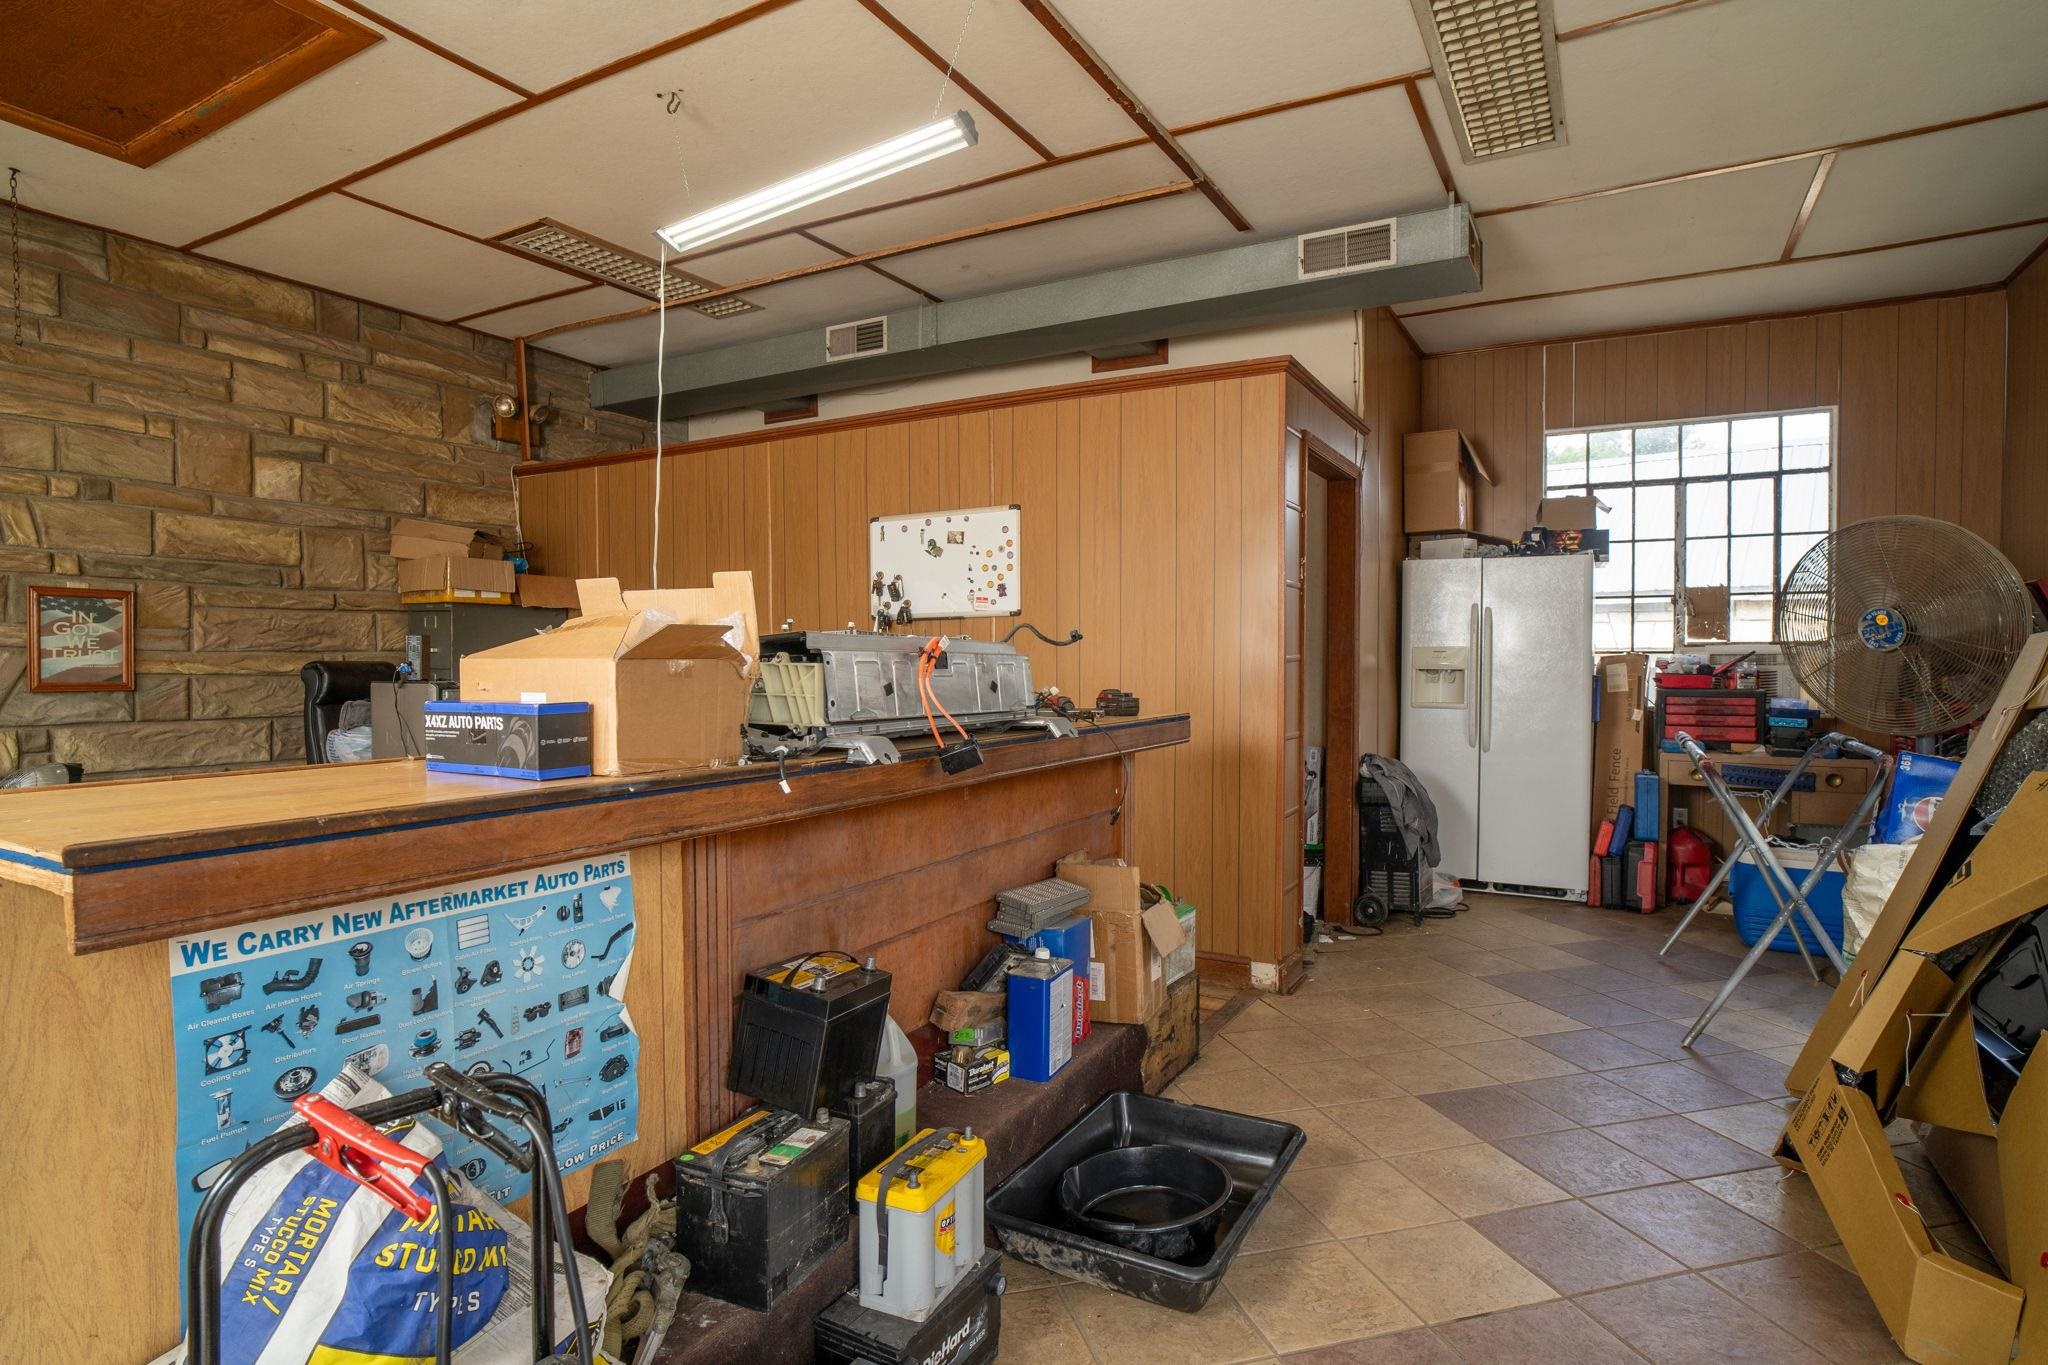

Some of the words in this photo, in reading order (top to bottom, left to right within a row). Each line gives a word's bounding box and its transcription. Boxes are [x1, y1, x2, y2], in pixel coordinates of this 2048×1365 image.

[71, 610, 94, 623] IN
[53, 622, 104, 635] GOD
[66, 636, 100, 649] WE
[46, 647, 119, 661] TRUST
[449, 716, 473, 730] AUTO
[474, 717, 504, 731] PARTS
[1608, 747, 1622, 782] Fence
[1899, 760, 1911, 771] 36
[1607, 786, 1619, 815] Field
[181, 940, 228, 968] WE
[237, 922, 325, 955] CARRY
[332, 909, 383, 936] NEW
[390, 879, 529, 924] AFTERMARKET
[534, 869, 579, 893] AUTO
[584, 857, 626, 882] PARTS
[343, 981, 355, 990] Air
[355, 976, 381, 989] Springs
[265, 1002, 277, 1011] Air
[277, 996, 300, 1007] Intake
[299, 990, 322, 1002] Hoses
[187, 1022, 200, 1031] Air
[200, 1015, 231, 1028] Cleaner
[231, 1008, 255, 1020] Boxes
[275, 1046, 317, 1064] Distributors
[200, 1073, 231, 1088] Cooling
[231, 1066, 251, 1077] Fans
[201, 1134, 219, 1146] Fuel
[220, 1125, 247, 1140] Pumps
[556, 1151, 585, 1171] LOW
[589, 1131, 625, 1158] PRICE
[252, 1216, 284, 1254] TYPE
[263, 1196, 317, 1265] STUCCO
[244, 1258, 257, 1268] S
[262, 1197, 338, 1316] MORTAR/
[241, 1267, 272, 1306] MIX
[467, 1291, 481, 1312] S
[968, 1328, 987, 1350] SILVER
